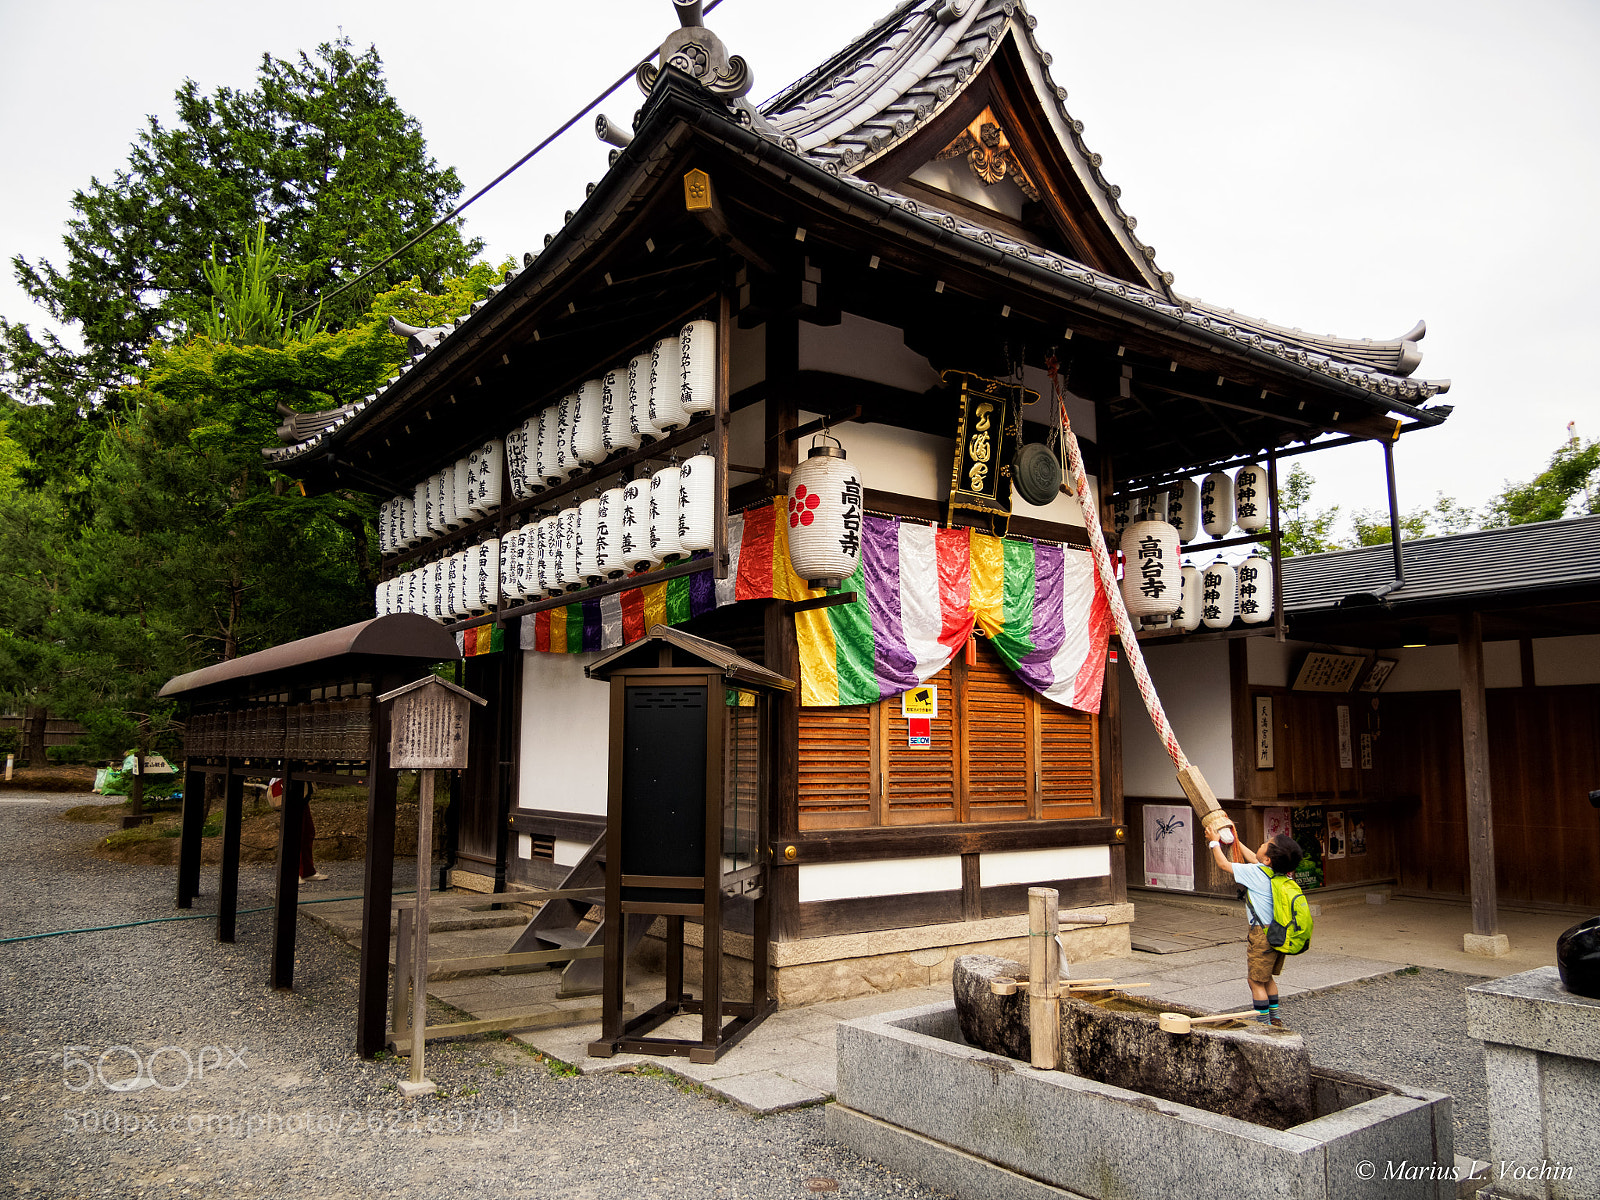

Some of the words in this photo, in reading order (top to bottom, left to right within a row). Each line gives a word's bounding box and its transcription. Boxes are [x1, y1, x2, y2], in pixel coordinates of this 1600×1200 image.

[838, 476, 861, 559] 高台寺
[1237, 470, 1258, 518] 御神燈
[1138, 535, 1167, 599] 高台寺
[1239, 565, 1260, 615] 御神燈
[1203, 571, 1222, 620] 御神燈
